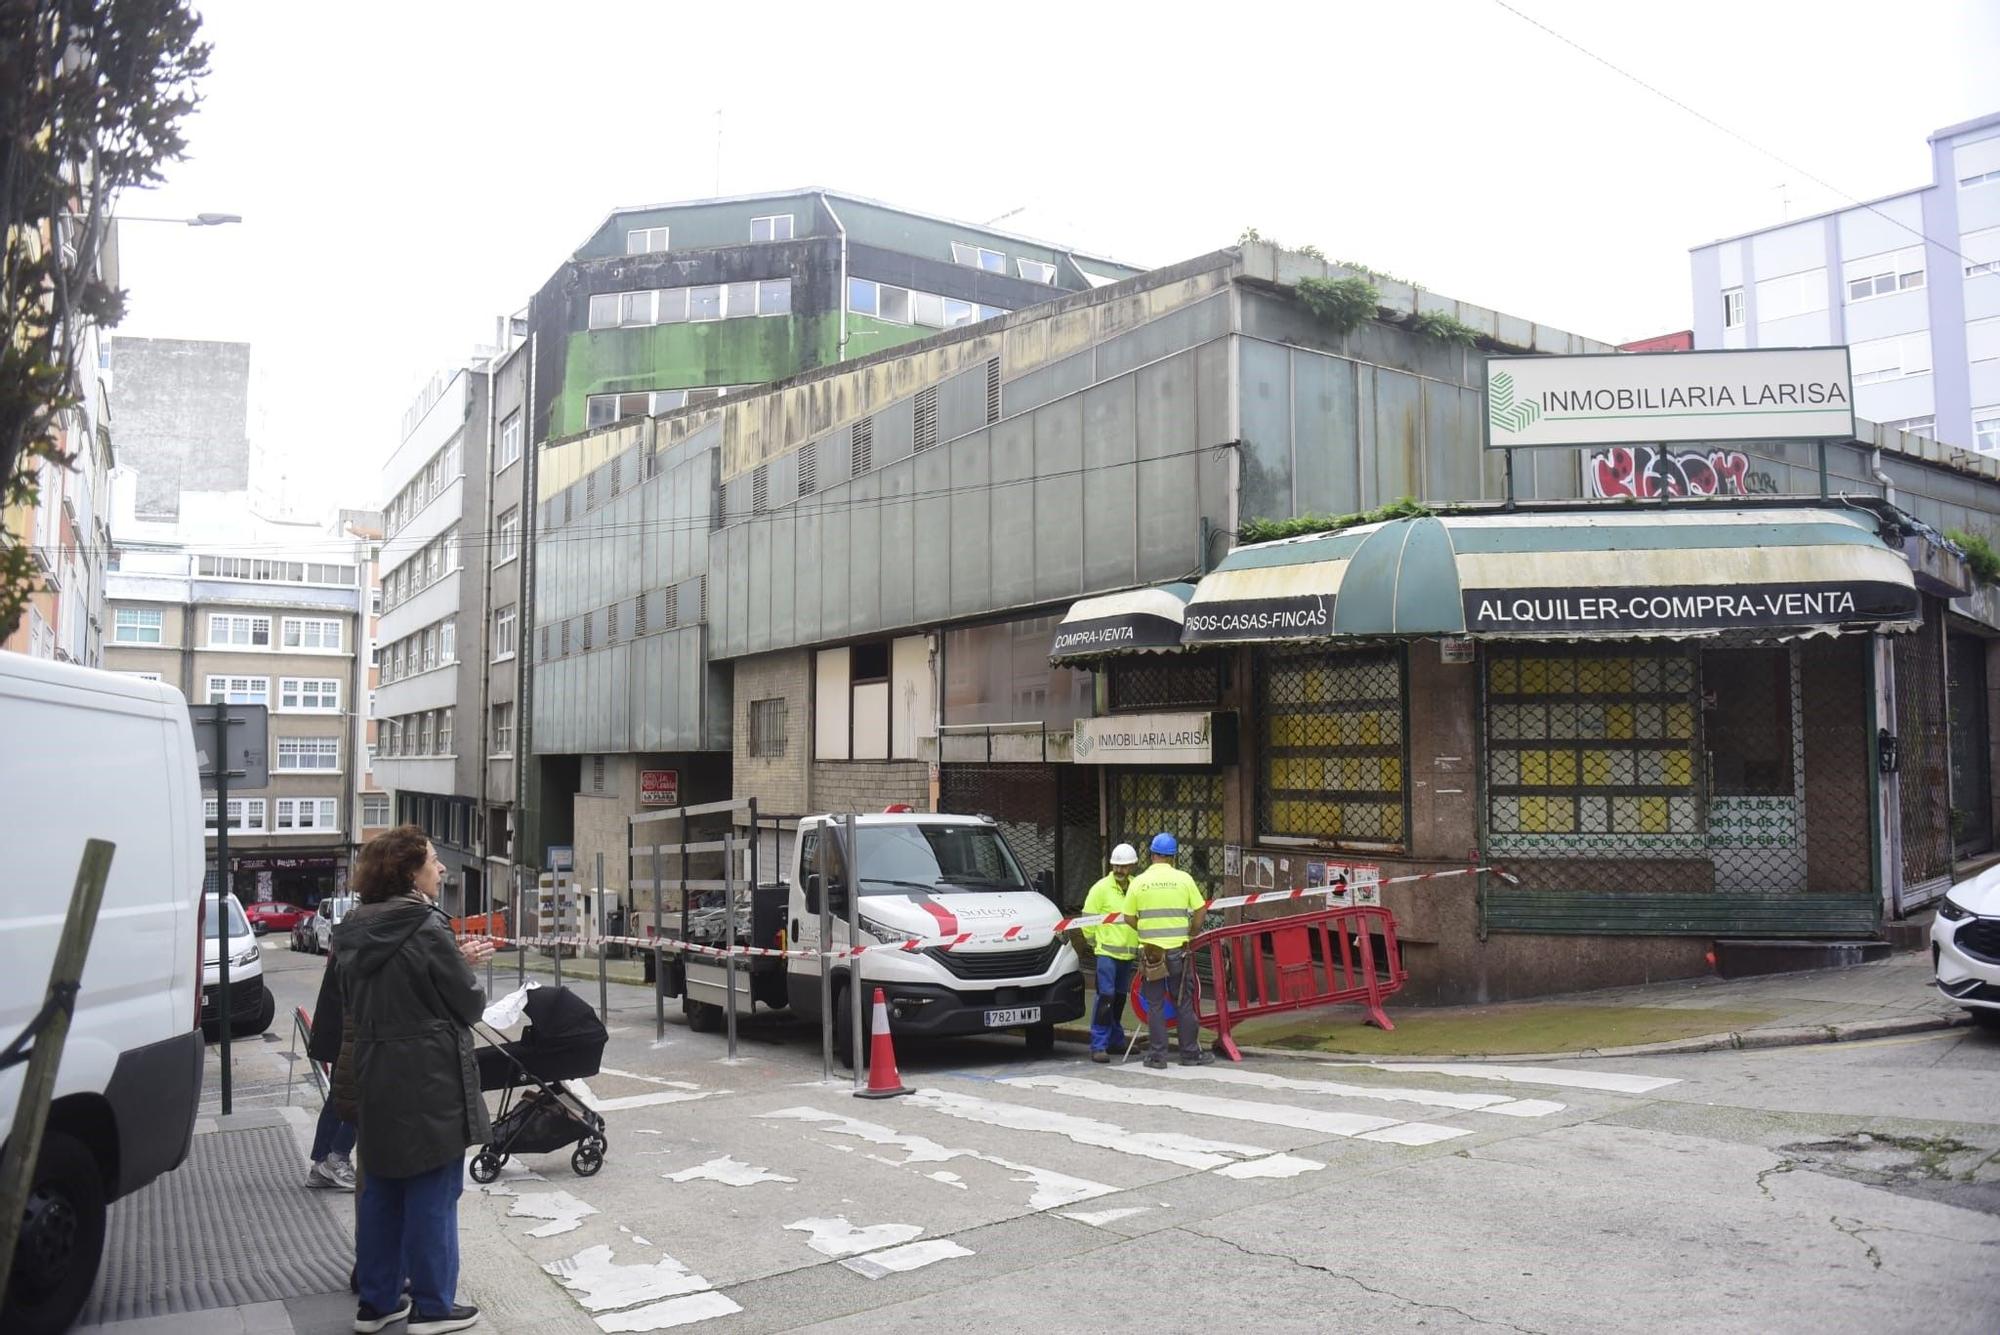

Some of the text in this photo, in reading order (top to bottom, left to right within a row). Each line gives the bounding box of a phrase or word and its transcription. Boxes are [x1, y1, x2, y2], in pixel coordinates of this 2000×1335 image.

[1542, 382, 1847, 412] INMOBILIARIA LARISA
[1477, 591, 1856, 622] ALQUILER-COMPRA-VENTA
[1185, 609, 1327, 632] PISOS-CASAS-FINCAS
[1055, 626, 1134, 648] COMPRA-VENTA
[1098, 730, 1209, 747] INMOBILIARIA LARISA
[992, 1011, 1016, 1023] 7821
